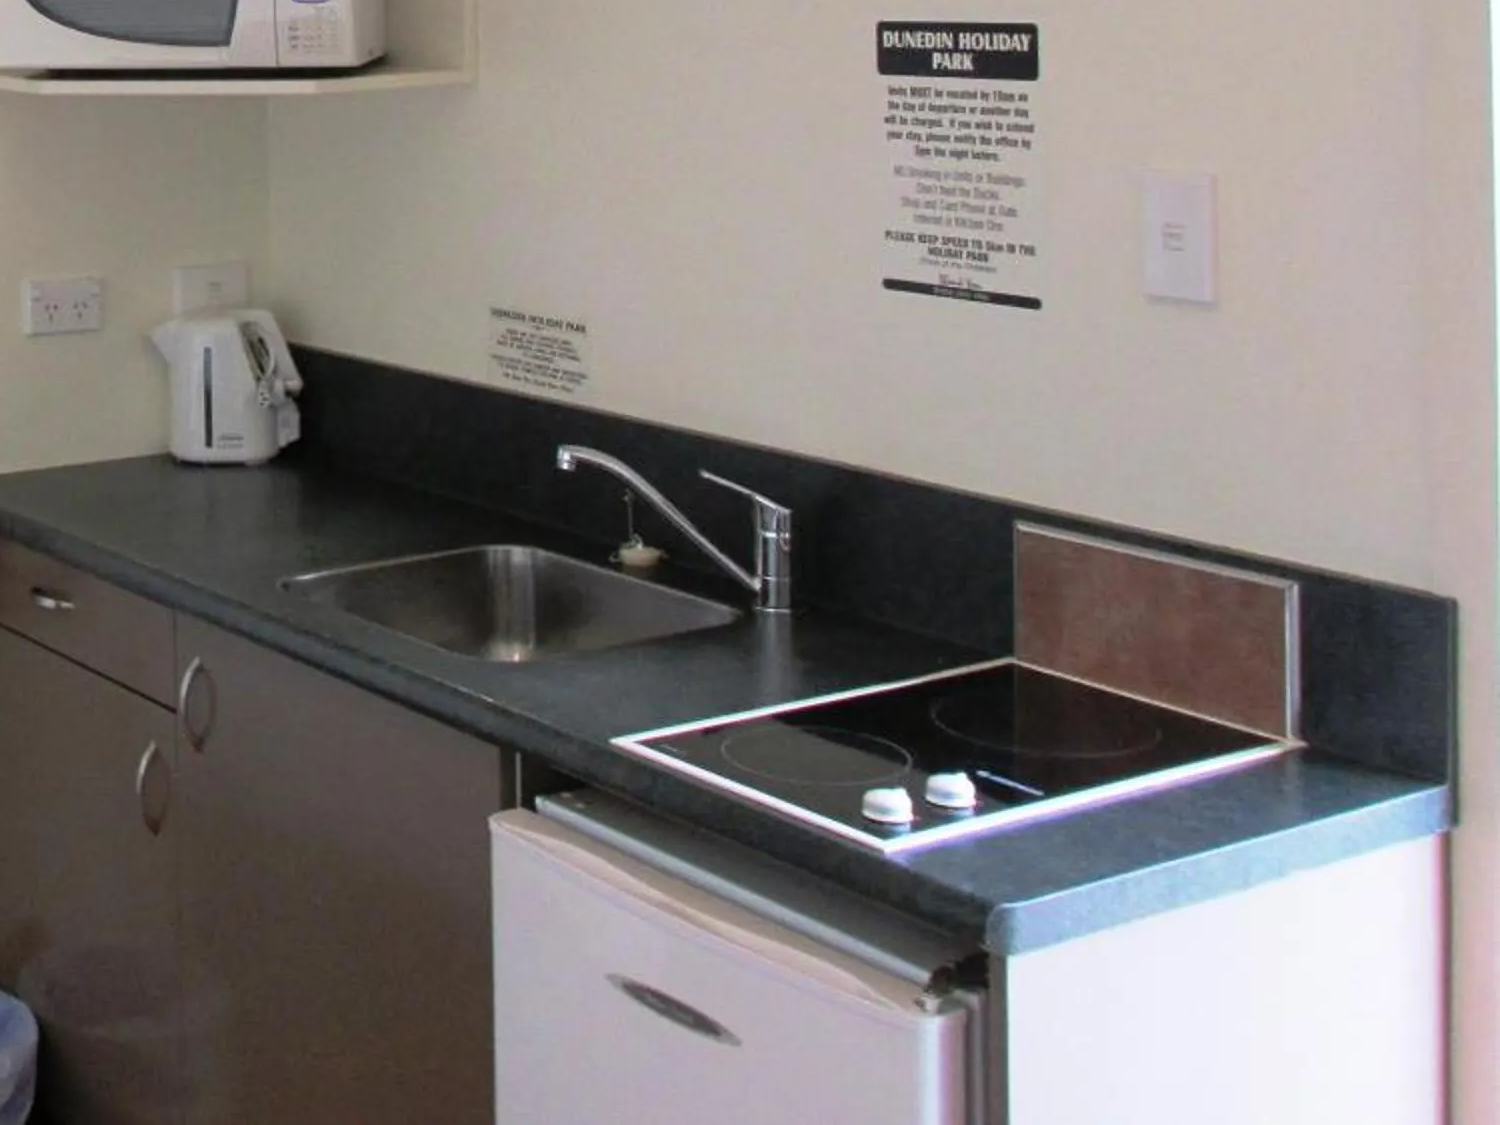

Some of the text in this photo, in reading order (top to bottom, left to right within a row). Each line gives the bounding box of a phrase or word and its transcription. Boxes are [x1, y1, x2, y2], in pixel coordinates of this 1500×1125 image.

[883, 31, 1031, 52] DUNEDIN HOLIDAY
[932, 52, 973, 70] PARK
